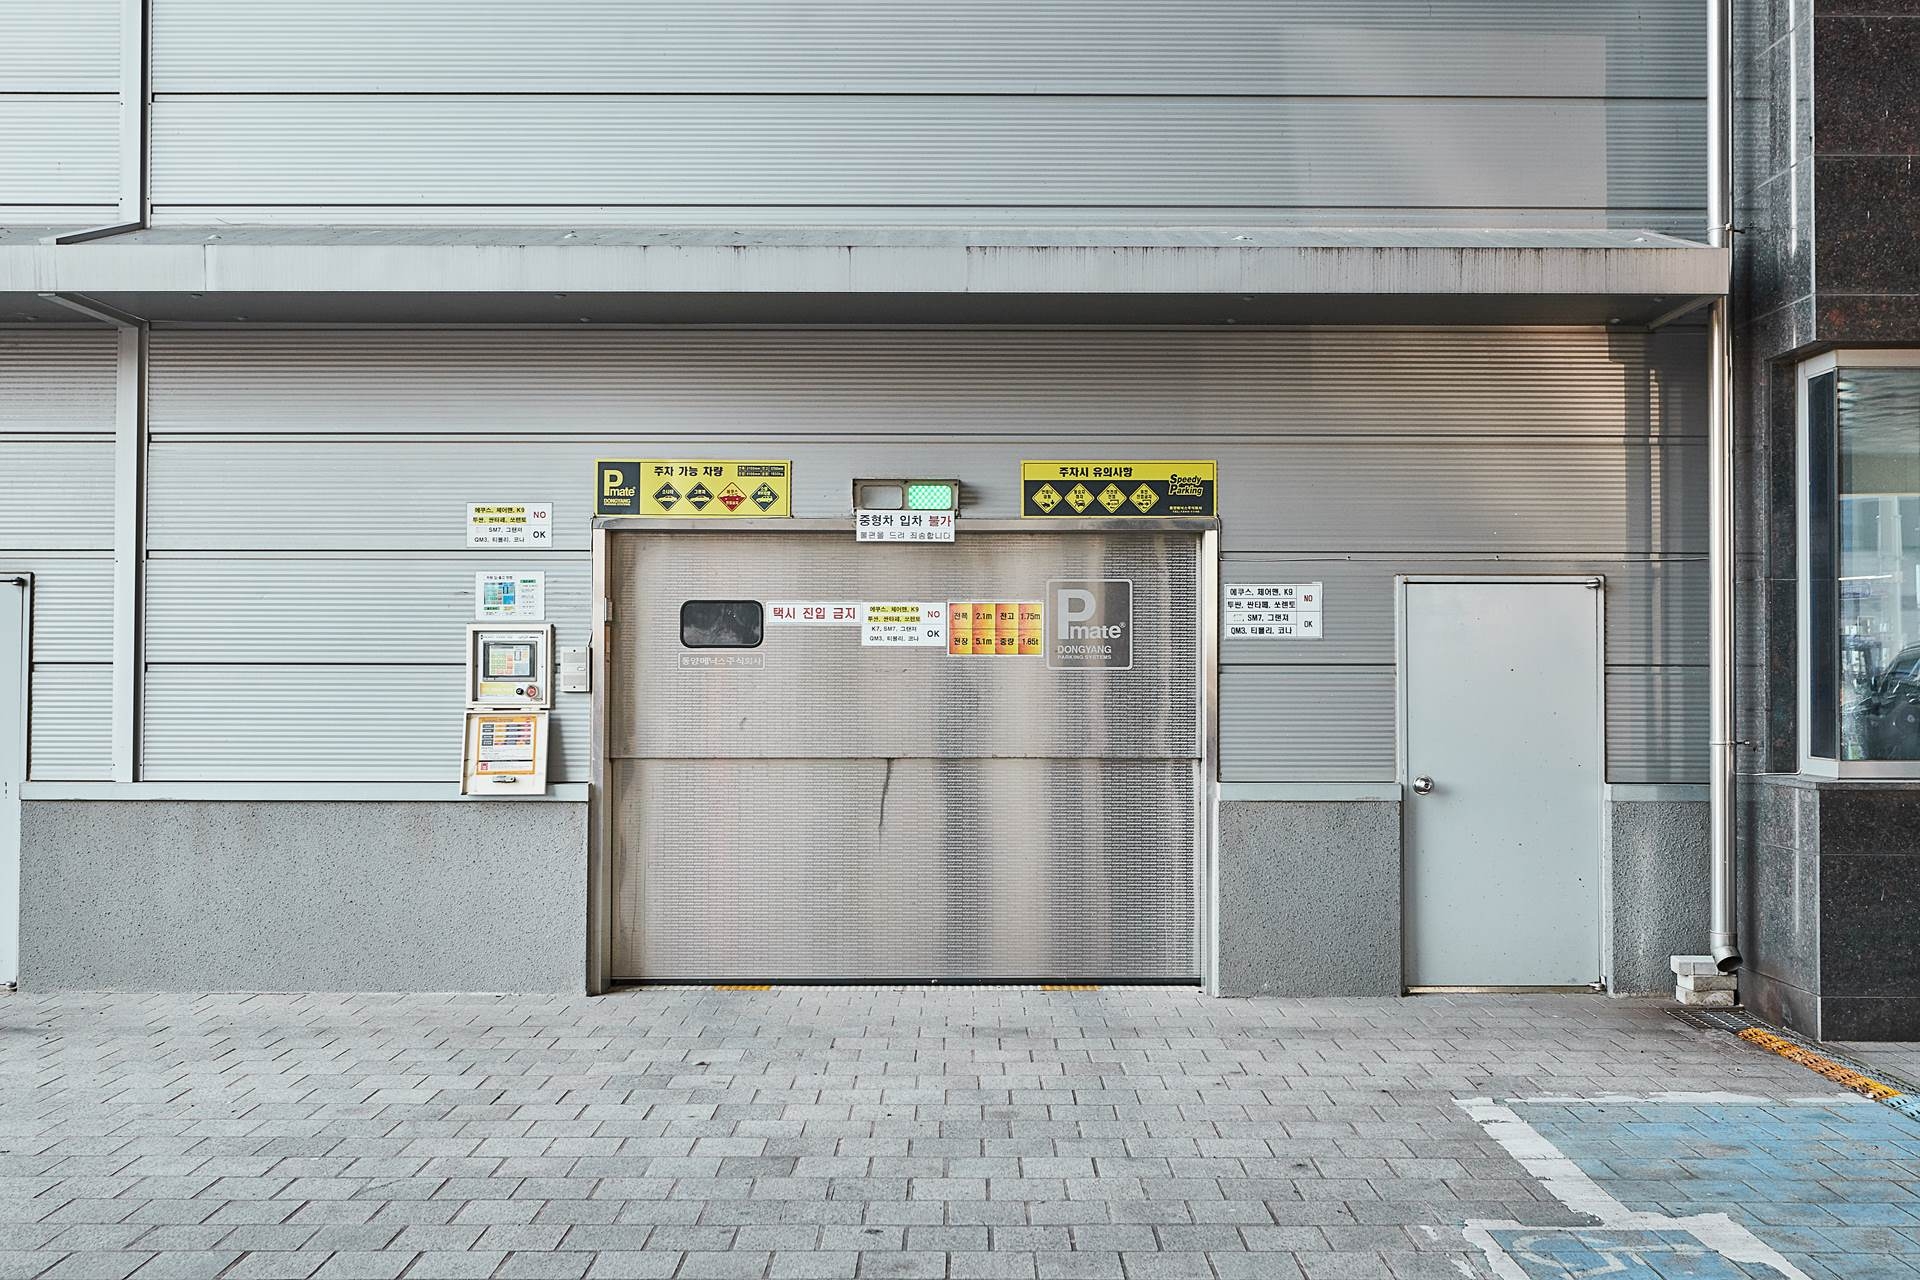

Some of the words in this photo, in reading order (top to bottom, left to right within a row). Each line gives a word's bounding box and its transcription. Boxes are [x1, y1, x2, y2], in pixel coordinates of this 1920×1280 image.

[654, 466, 674, 477] 주차
[679, 466, 699, 477] 가능
[703, 466, 723, 477] 차량
[1059, 467, 1089, 478] 주차시
[1093, 467, 1133, 478] 유의사항
[1169, 473, 1202, 485] Speedy
[1168, 484, 1203, 497] Parking
[533, 511, 546, 519] NO
[859, 514, 894, 527] 중형차
[900, 514, 923, 527] 입차
[929, 515, 951, 527] 불가
[1283, 588, 1293, 596] K9
[1303, 594, 1313, 602] NO
[773, 607, 796, 619] 택시
[803, 607, 826, 619] 진입
[833, 607, 856, 619] 금지
[928, 610, 941, 618] NO
[976, 612, 993, 620] 2.1m
[1000, 612, 1015, 620] 전고
[1021, 612, 1041, 620] 1.75m
[1057, 588, 1122, 640] Pmate
[1303, 620, 1313, 628] OK
[927, 630, 940, 638] OK
[1278, 626, 1293, 635] 코나
[976, 637, 993, 645] 5.1m
[1000, 637, 1015, 646] 중량
[1057, 645, 1112, 654] DONGYANG
